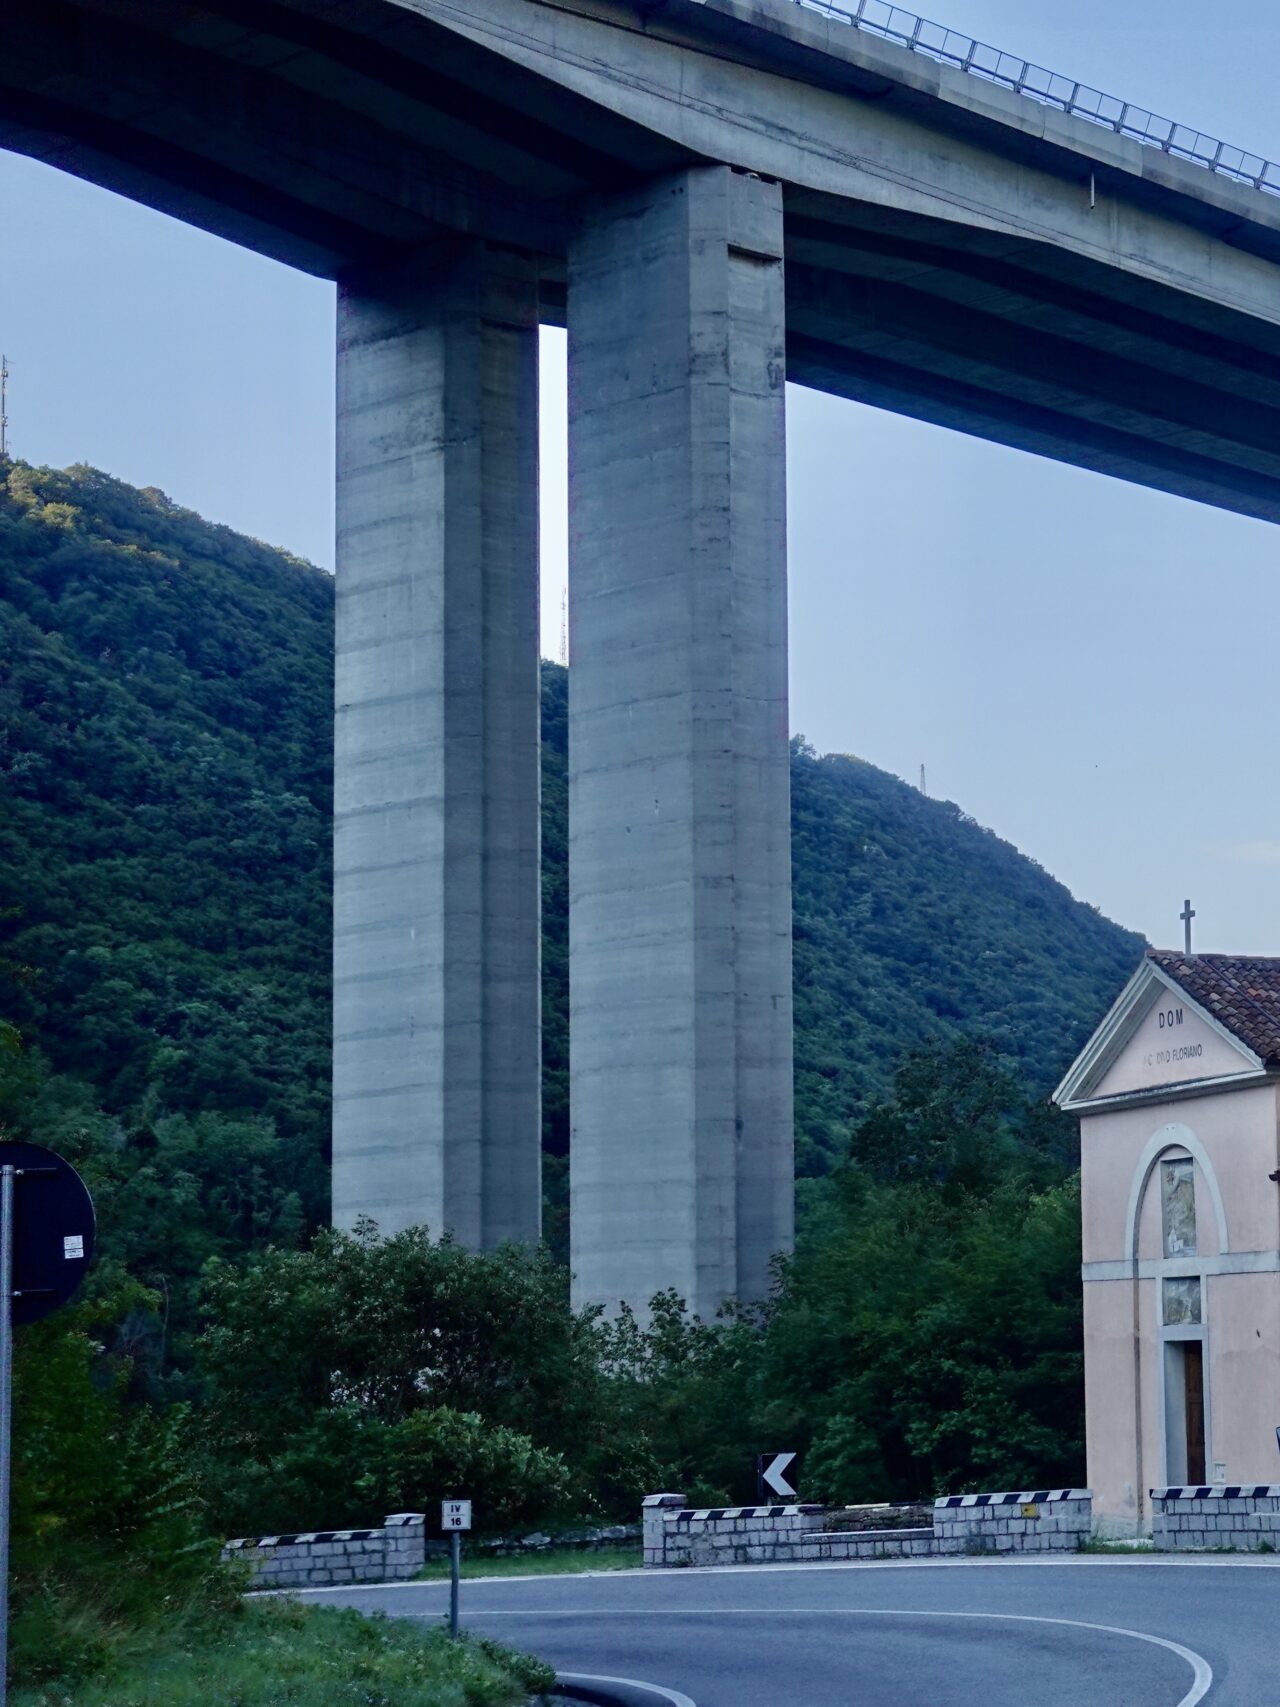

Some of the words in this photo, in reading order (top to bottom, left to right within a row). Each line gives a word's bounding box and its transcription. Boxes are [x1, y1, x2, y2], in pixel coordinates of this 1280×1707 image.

[1158, 1008, 1184, 1029] DOM
[1172, 1043, 1203, 1061] FLORIANO
[450, 1504, 461, 1513] IV
[450, 1517, 462, 1526] 16
